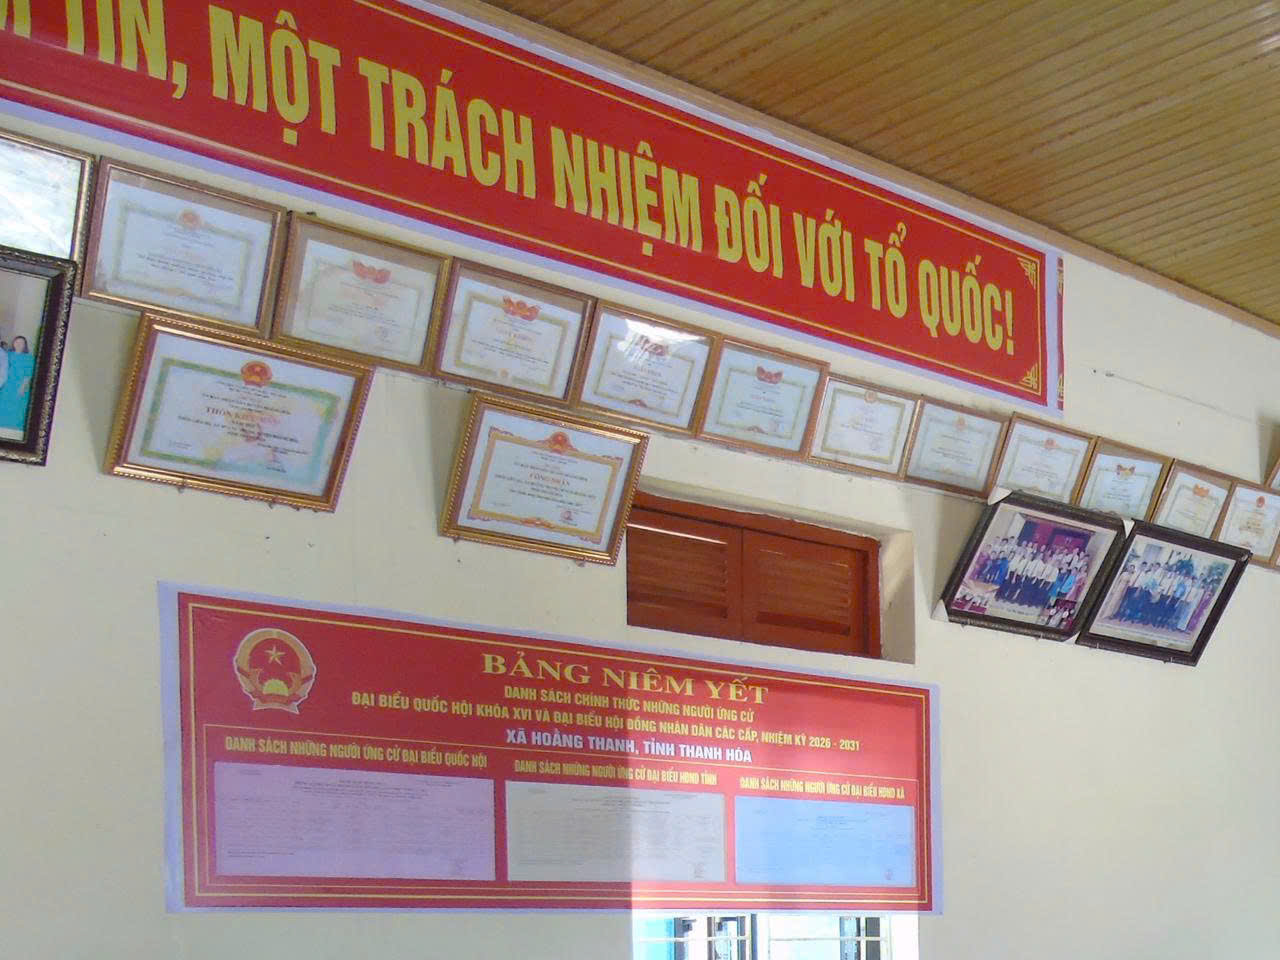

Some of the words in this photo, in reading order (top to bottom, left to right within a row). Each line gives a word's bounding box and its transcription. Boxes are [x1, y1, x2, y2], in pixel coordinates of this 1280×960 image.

[208, 4, 341, 146] MỘT
[358, 56, 537, 200] TRÁCH
[550, 125, 704, 257] NHIỆM
[714, 173, 784, 280] ĐỐI
[793, 208, 856, 303] VỚI
[864, 221, 909, 319] TỔ
[918, 254, 1015, 356] QUỐC!
[482, 651, 591, 685] BẢNG
[603, 668, 695, 697] NIÊM
[705, 675, 769, 705] YẾT
[351, 691, 374, 710] ĐẠI
[378, 690, 410, 710] BIỂU
[413, 695, 448, 714] QUỐC
[451, 699, 473, 719] HỘI
[476, 702, 509, 720] KHÓA
[513, 707, 532, 721] XVI
[535, 707, 550, 723] VÀ
[553, 711, 574, 727] ĐẠI
[576, 710, 603, 728] BIỂU
[605, 714, 624, 731] HỘI
[626, 716, 656, 732] ĐỒNG
[659, 720, 689, 737] NHÂN
[691, 722, 713, 738] DÂN
[715, 724, 736, 740] CÁC
[737, 724, 760, 744] CẤP,
[808, 736, 832, 750] 2026
[839, 739, 860, 752] 2031
[504, 685, 537, 701] DANH
[540, 686, 572, 704] SÁCH
[574, 690, 609, 708] CHÍNH
[612, 693, 641, 711] THỨC
[643, 697, 680, 716] NHỮNG
[682, 701, 714, 719] NGƯỜI
[716, 705, 738, 722] ỨNG
[739, 706, 755, 723] CỬ
[225, 736, 256, 752] DANH
[258, 736, 288, 754] SÁCH
[290, 740, 327, 757] NHỮNG
[330, 742, 361, 760] NGƯỜI
[363, 743, 384, 761] ỨNG
[386, 745, 401, 762] CỬ
[402, 748, 419, 765] ĐẠI
[421, 746, 442, 765] BIỂU
[444, 749, 470, 767] QUỐC
[471, 751, 488, 770] HỘI
[506, 728, 527, 744] XÃ
[588, 735, 639, 755] THANH,
[643, 739, 675, 757] TỈNH
[679, 743, 722, 761] THANH
[726, 745, 752, 763] HÓA
